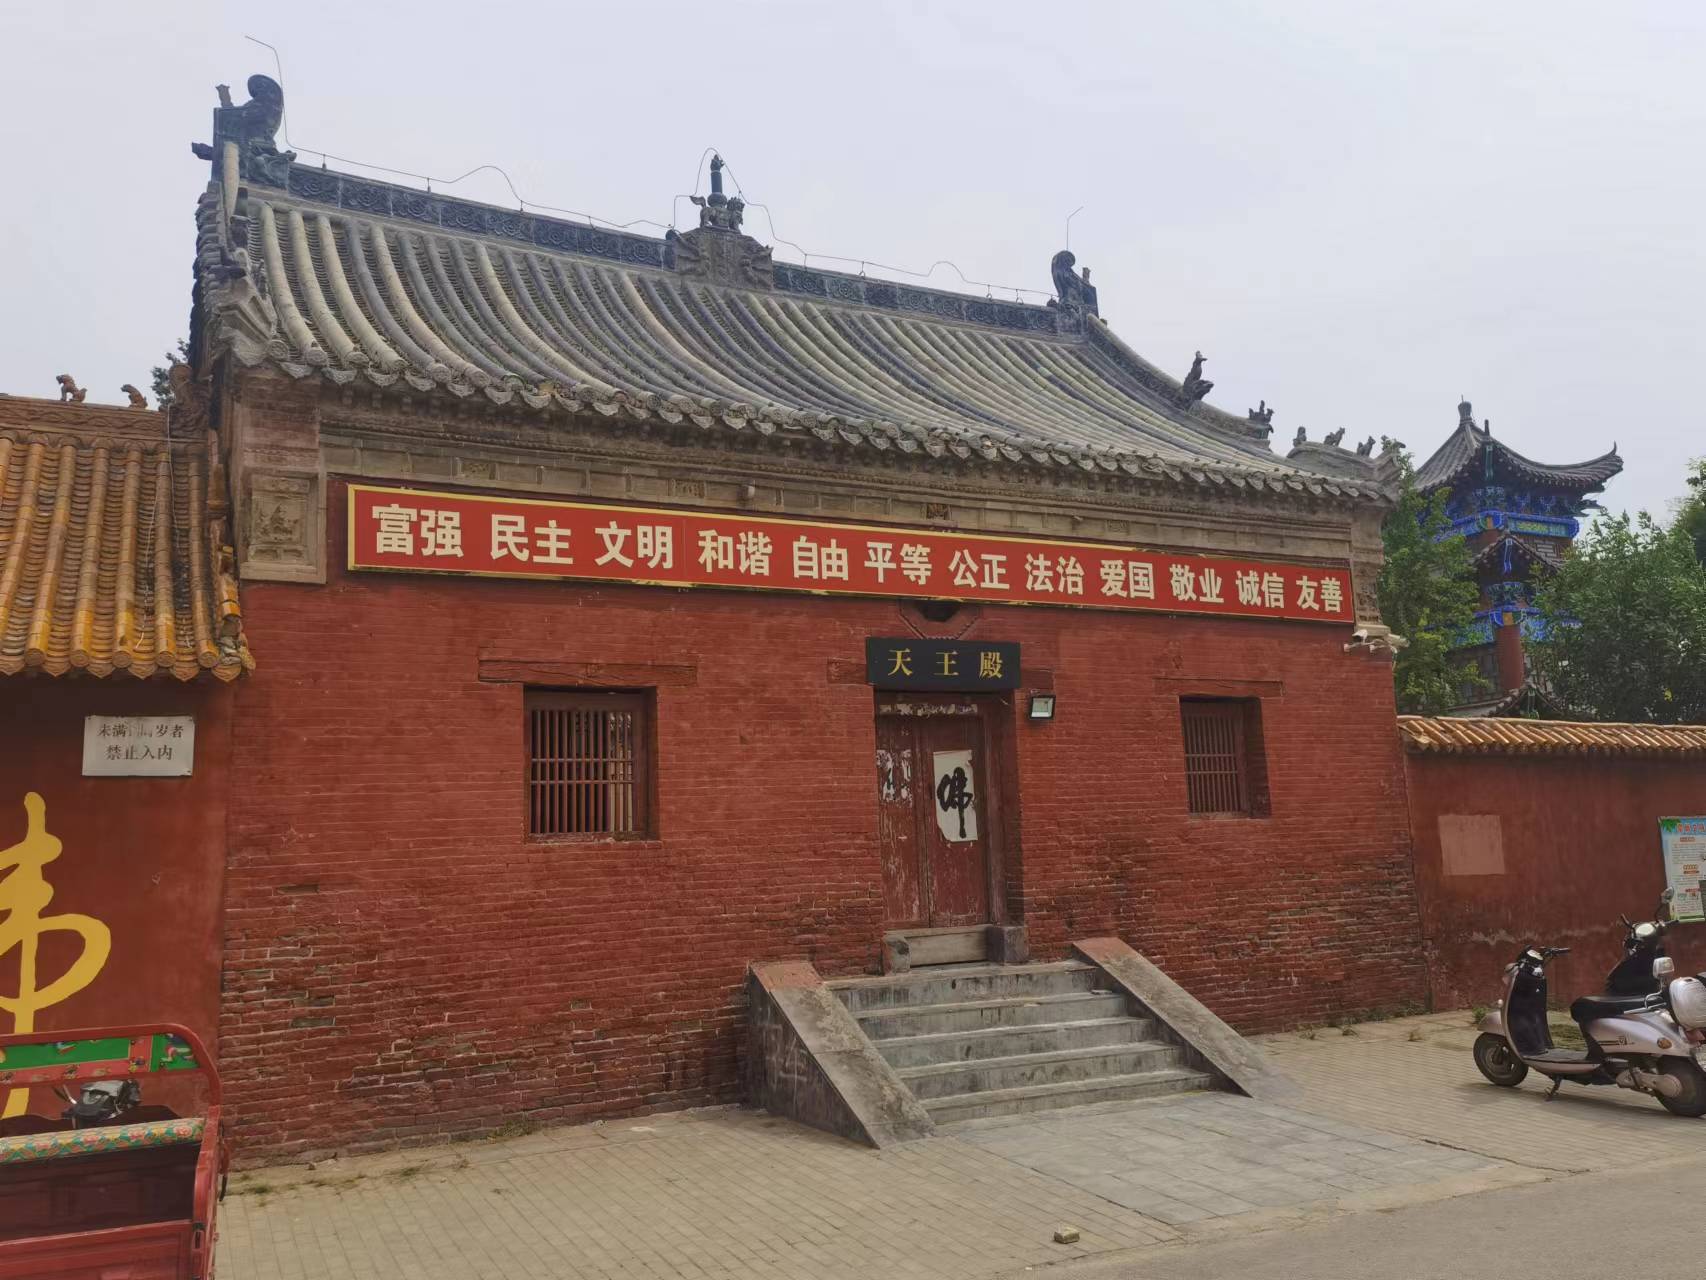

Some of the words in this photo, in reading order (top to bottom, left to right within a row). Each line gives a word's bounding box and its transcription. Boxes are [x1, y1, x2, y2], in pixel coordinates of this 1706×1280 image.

[372, 503, 464, 558] 富强
[490, 513, 573, 565] 民主
[594, 520, 673, 569] 文明
[698, 529, 773, 576] 和谐
[792, 535, 849, 581] 自由
[864, 541, 932, 585] 平等
[948, 549, 1010, 590] 公正
[1024, 553, 1085, 595] 法治
[1100, 559, 1155, 599] 爱国
[1169, 563, 1224, 603] 敬业
[1236, 570, 1285, 608] 诚信
[1296, 575, 1343, 612] 友善
[887, 648, 1003, 678] 天王殿
[106, 744, 173, 761] 禁止入内
